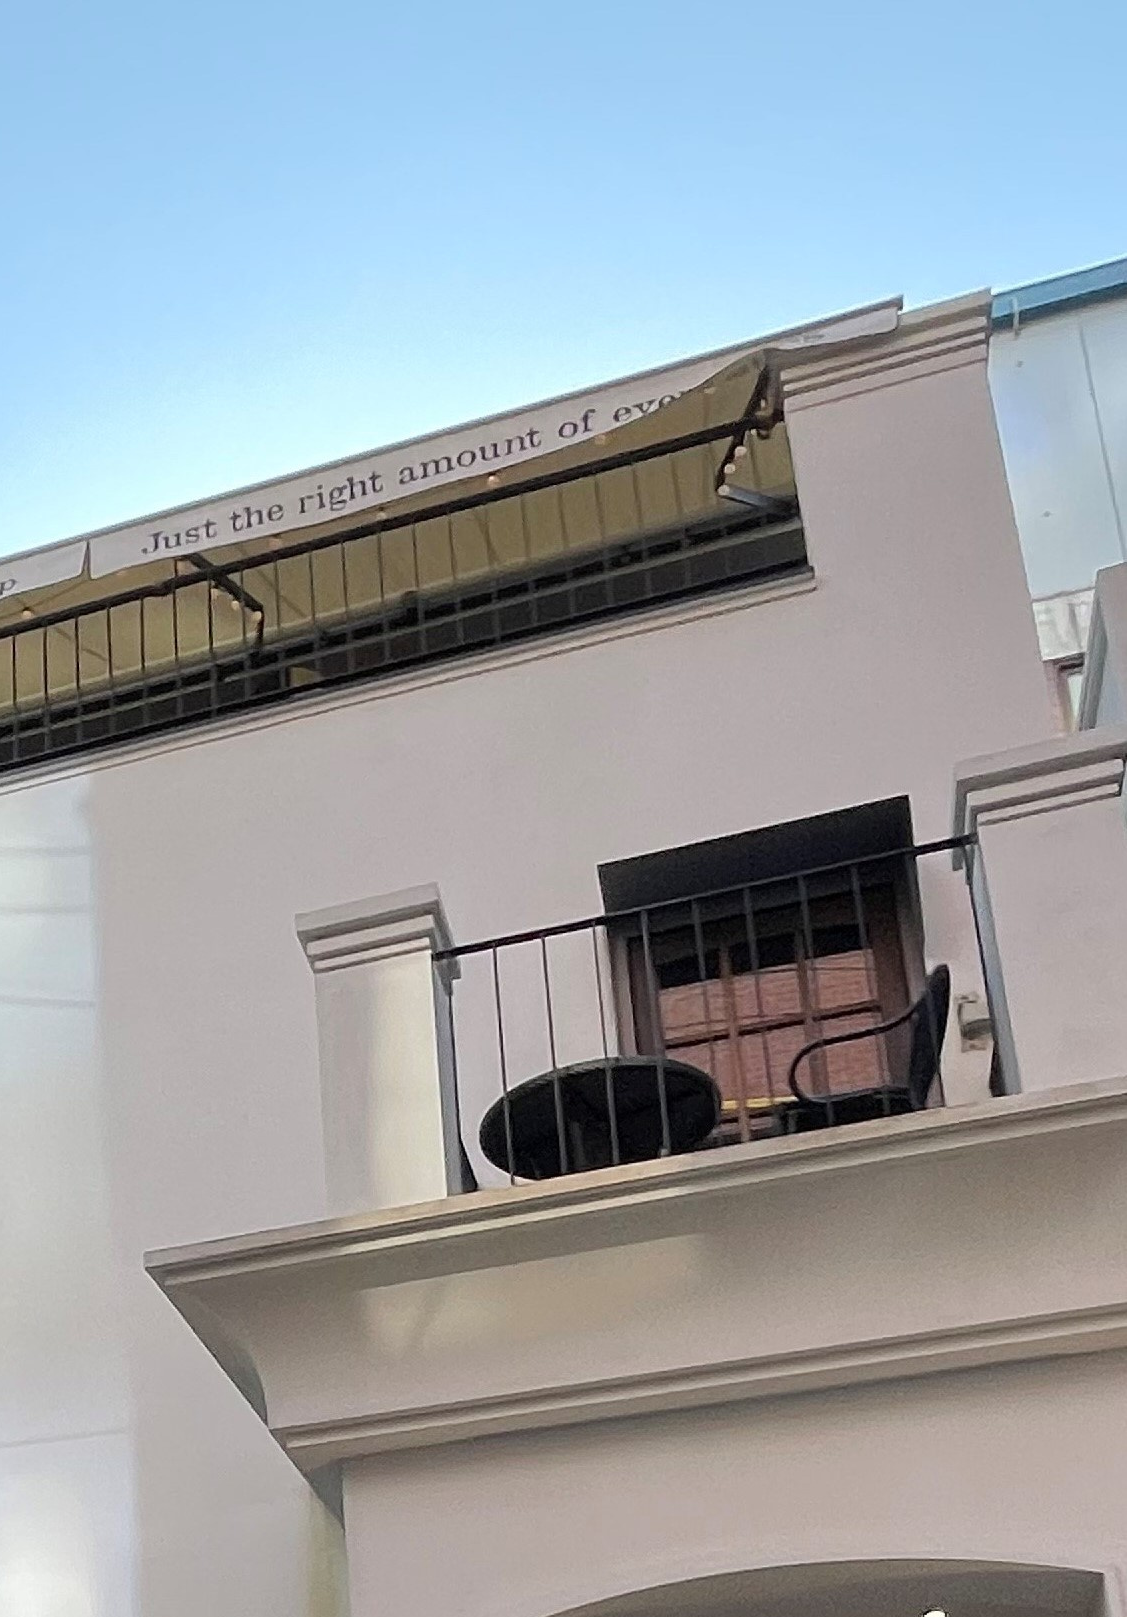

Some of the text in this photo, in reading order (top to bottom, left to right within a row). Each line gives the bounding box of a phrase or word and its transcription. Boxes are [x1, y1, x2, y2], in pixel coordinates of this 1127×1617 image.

[140, 517, 217, 555] Just
[228, 504, 285, 532] the
[297, 470, 384, 514] right
[397, 426, 542, 485] amount
[558, 408, 597, 439] of
